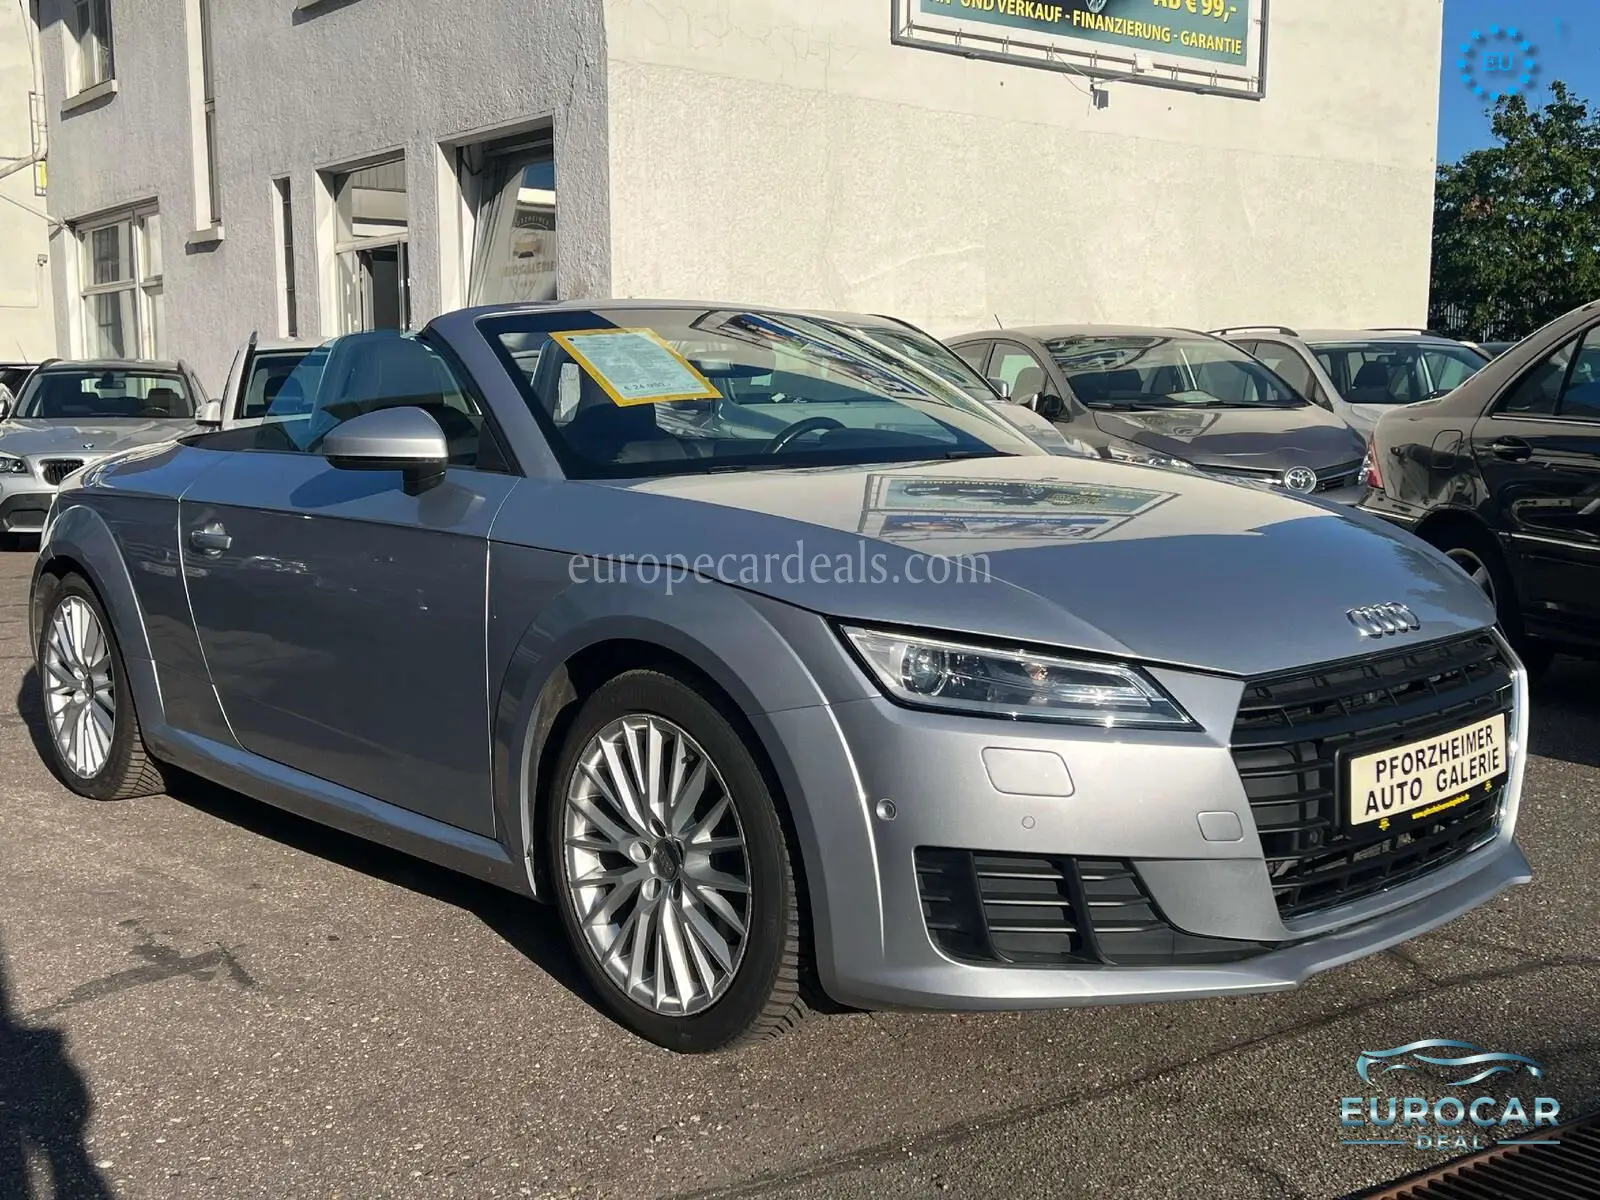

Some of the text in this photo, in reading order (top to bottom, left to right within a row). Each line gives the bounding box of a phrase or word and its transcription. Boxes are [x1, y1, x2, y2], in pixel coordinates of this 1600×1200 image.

[998, 0, 1063, 23] VERKAUF
[1073, 10, 1171, 43] FINANZIERUNG
[1180, 30, 1242, 55] GARANTIE
[1364, 777, 1423, 816] AUTO
[1436, 747, 1500, 793] GALERIE
[1376, 724, 1493, 783] PFORZHEIMER
